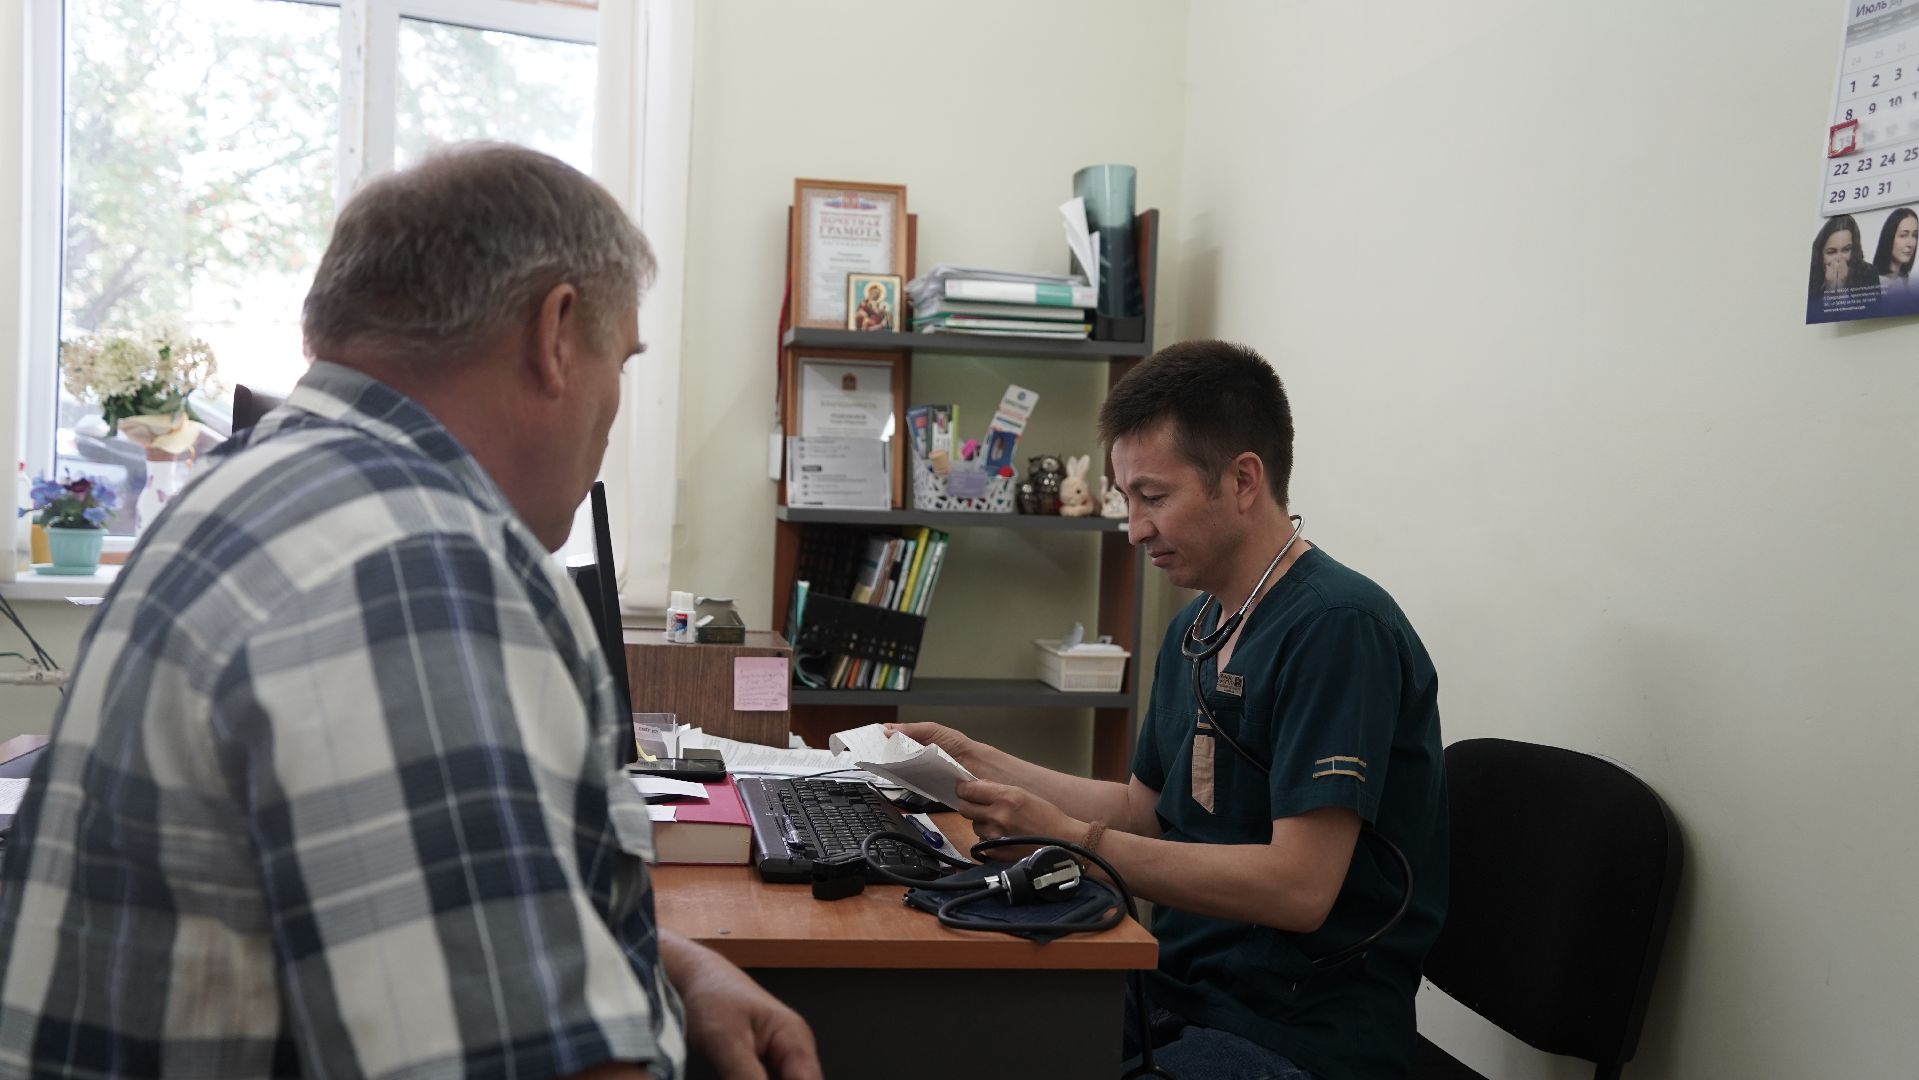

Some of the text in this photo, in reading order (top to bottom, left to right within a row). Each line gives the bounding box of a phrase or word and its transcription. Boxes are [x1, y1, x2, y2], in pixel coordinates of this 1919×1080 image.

[1855, 0, 1888, 17] Июль
[1850, 80, 1856, 93] 1
[1871, 74, 1880, 87] 2
[1894, 67, 1902, 81] 3
[1845, 108, 1853, 121] 8
[1868, 102, 1876, 115] 9
[1833, 146, 1919, 176] 22 23 24 25
[1829, 189, 1846, 203] 29
[1853, 185, 1870, 200] 30
[1877, 180, 1892, 195] 31
[819, 225, 881, 238] ГРАМОТА
